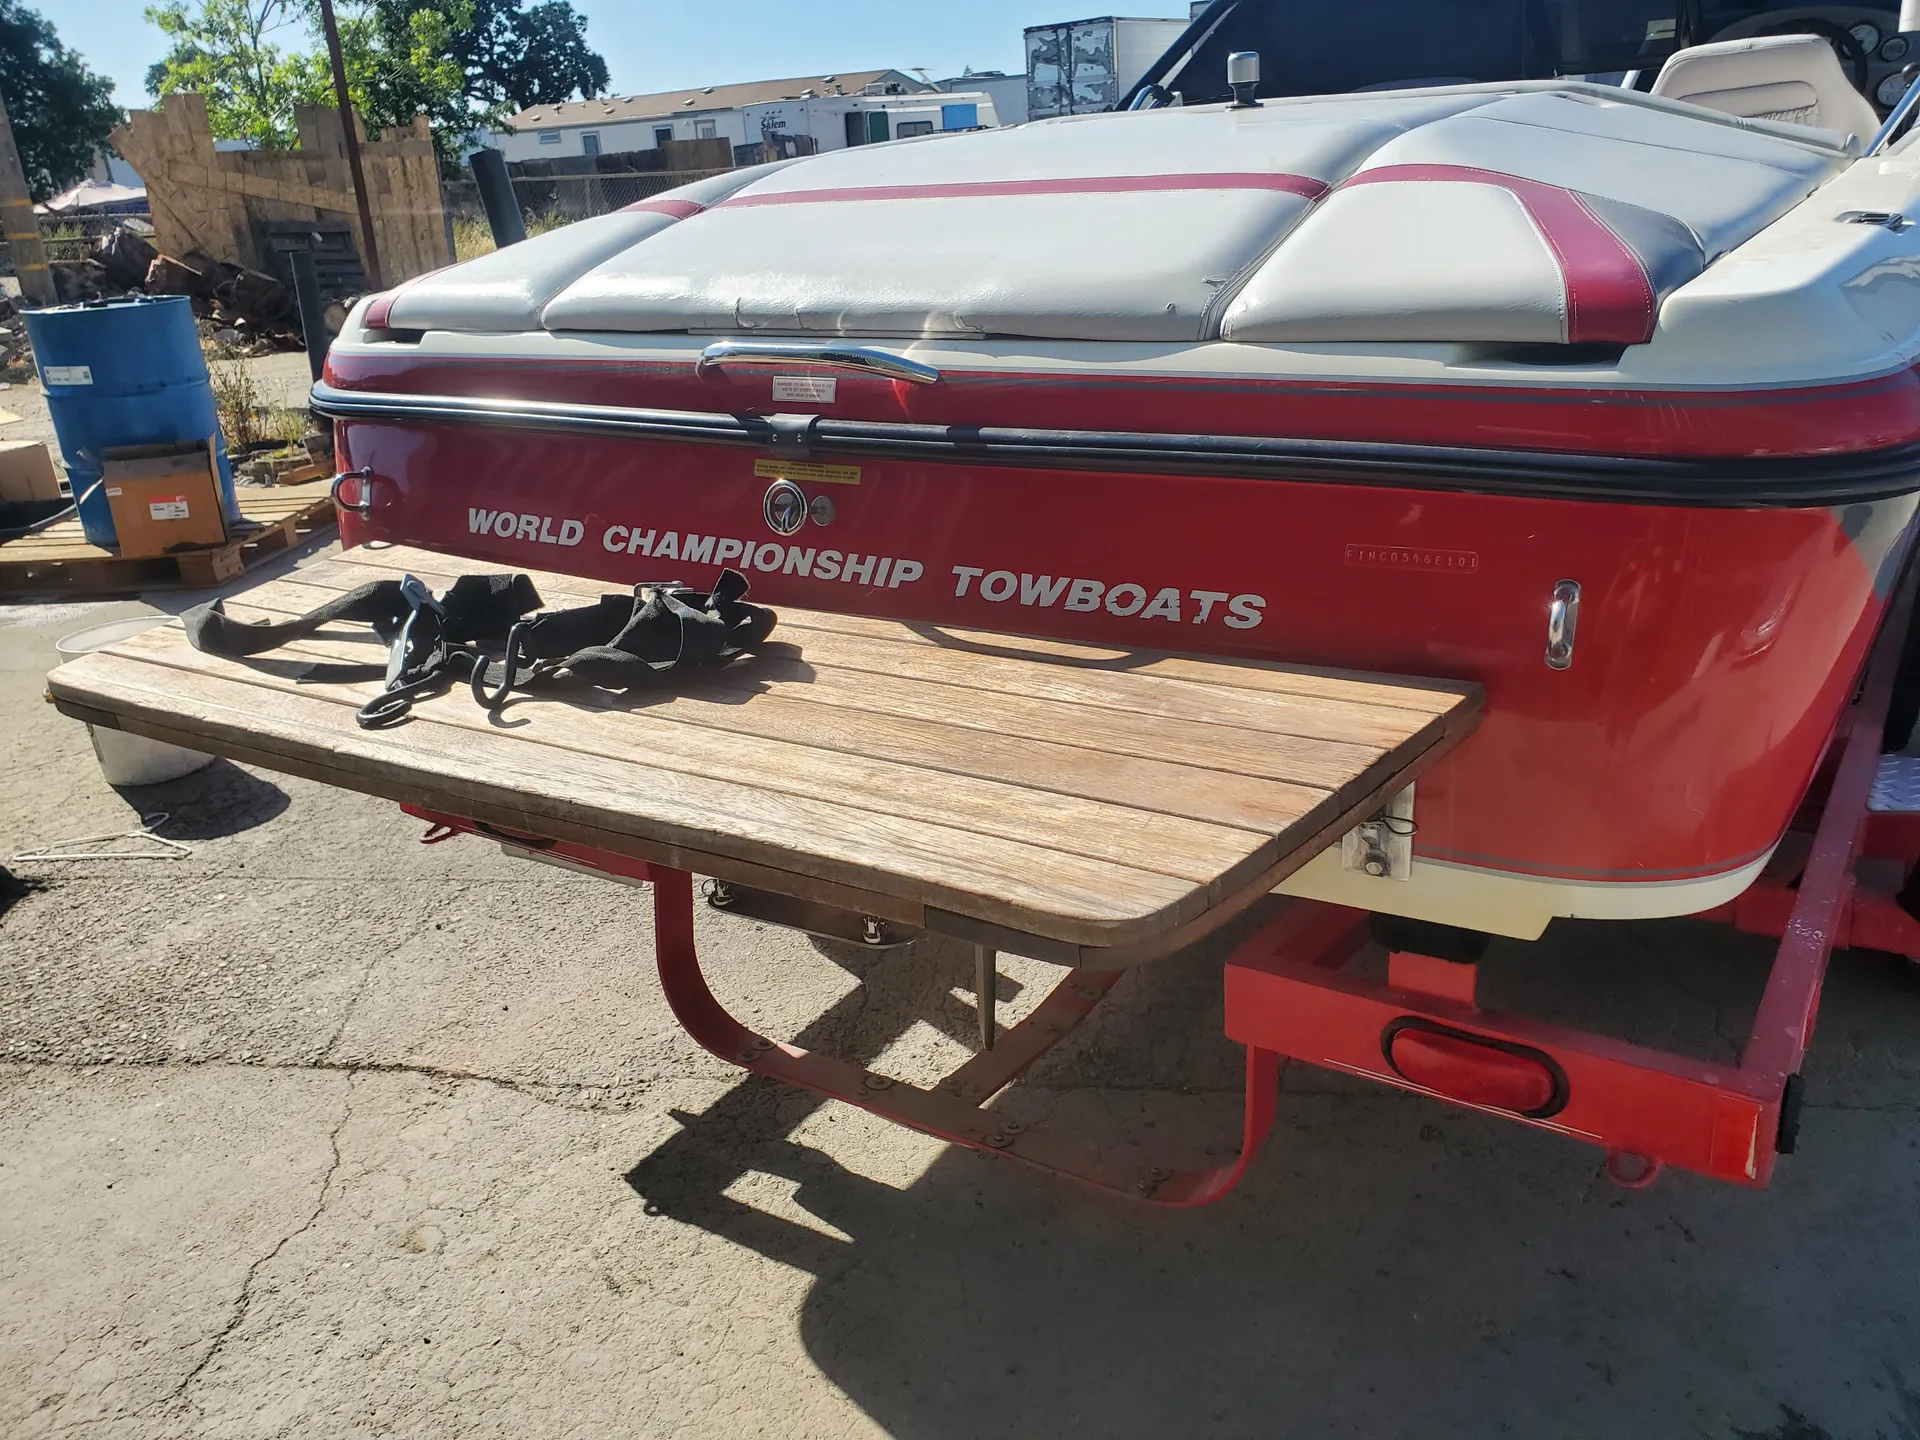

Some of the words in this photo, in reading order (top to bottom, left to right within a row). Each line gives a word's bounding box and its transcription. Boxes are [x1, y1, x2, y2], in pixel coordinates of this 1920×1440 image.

[761, 117, 786, 130] Salem
[468, 508, 584, 547] WORLD
[603, 525, 924, 588] CHAMPIONSHIP
[951, 565, 1267, 629] TOWBOATS
